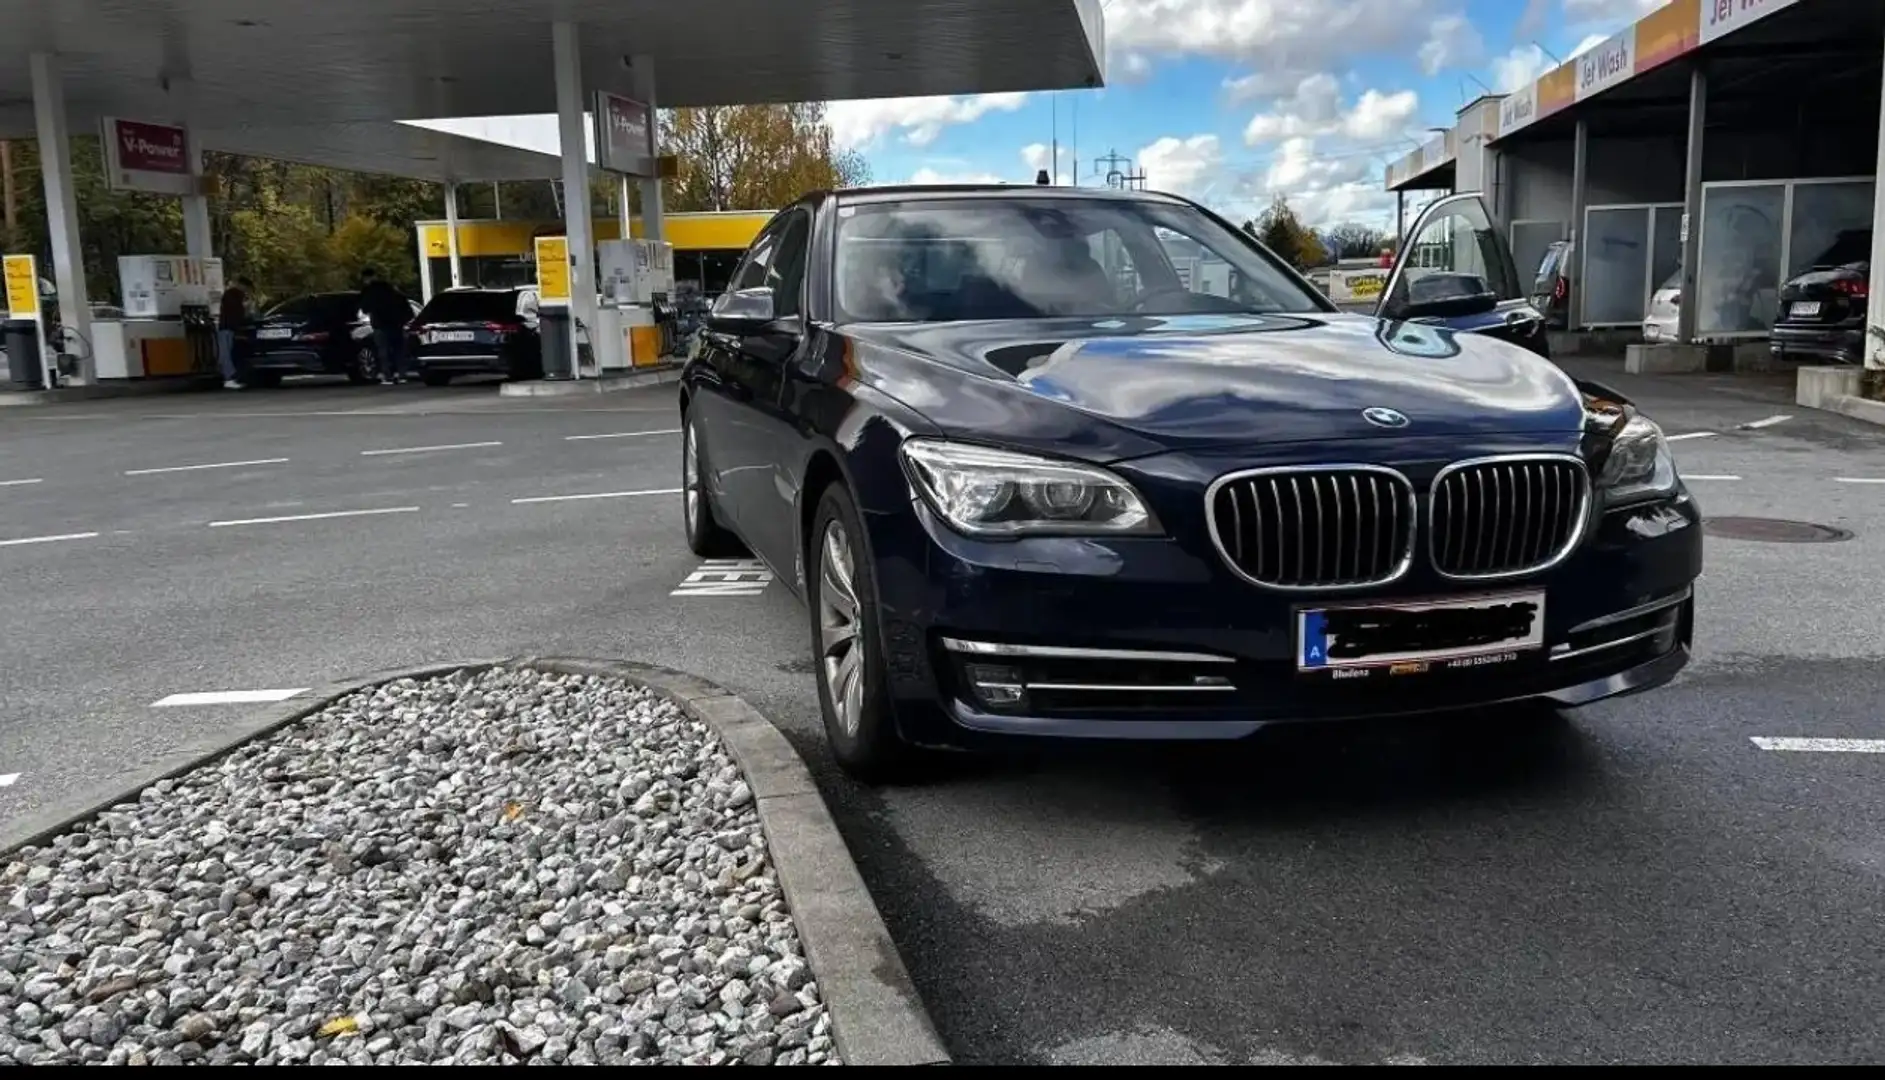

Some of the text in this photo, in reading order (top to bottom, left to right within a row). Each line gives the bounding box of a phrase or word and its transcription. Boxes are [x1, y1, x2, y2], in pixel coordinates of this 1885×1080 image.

[1710, 0, 1732, 26] Jet
[1581, 37, 1628, 90] Jet Wash
[611, 112, 647, 137] V-Power
[123, 135, 181, 158] V-Power
[1309, 645, 1321, 658] A
